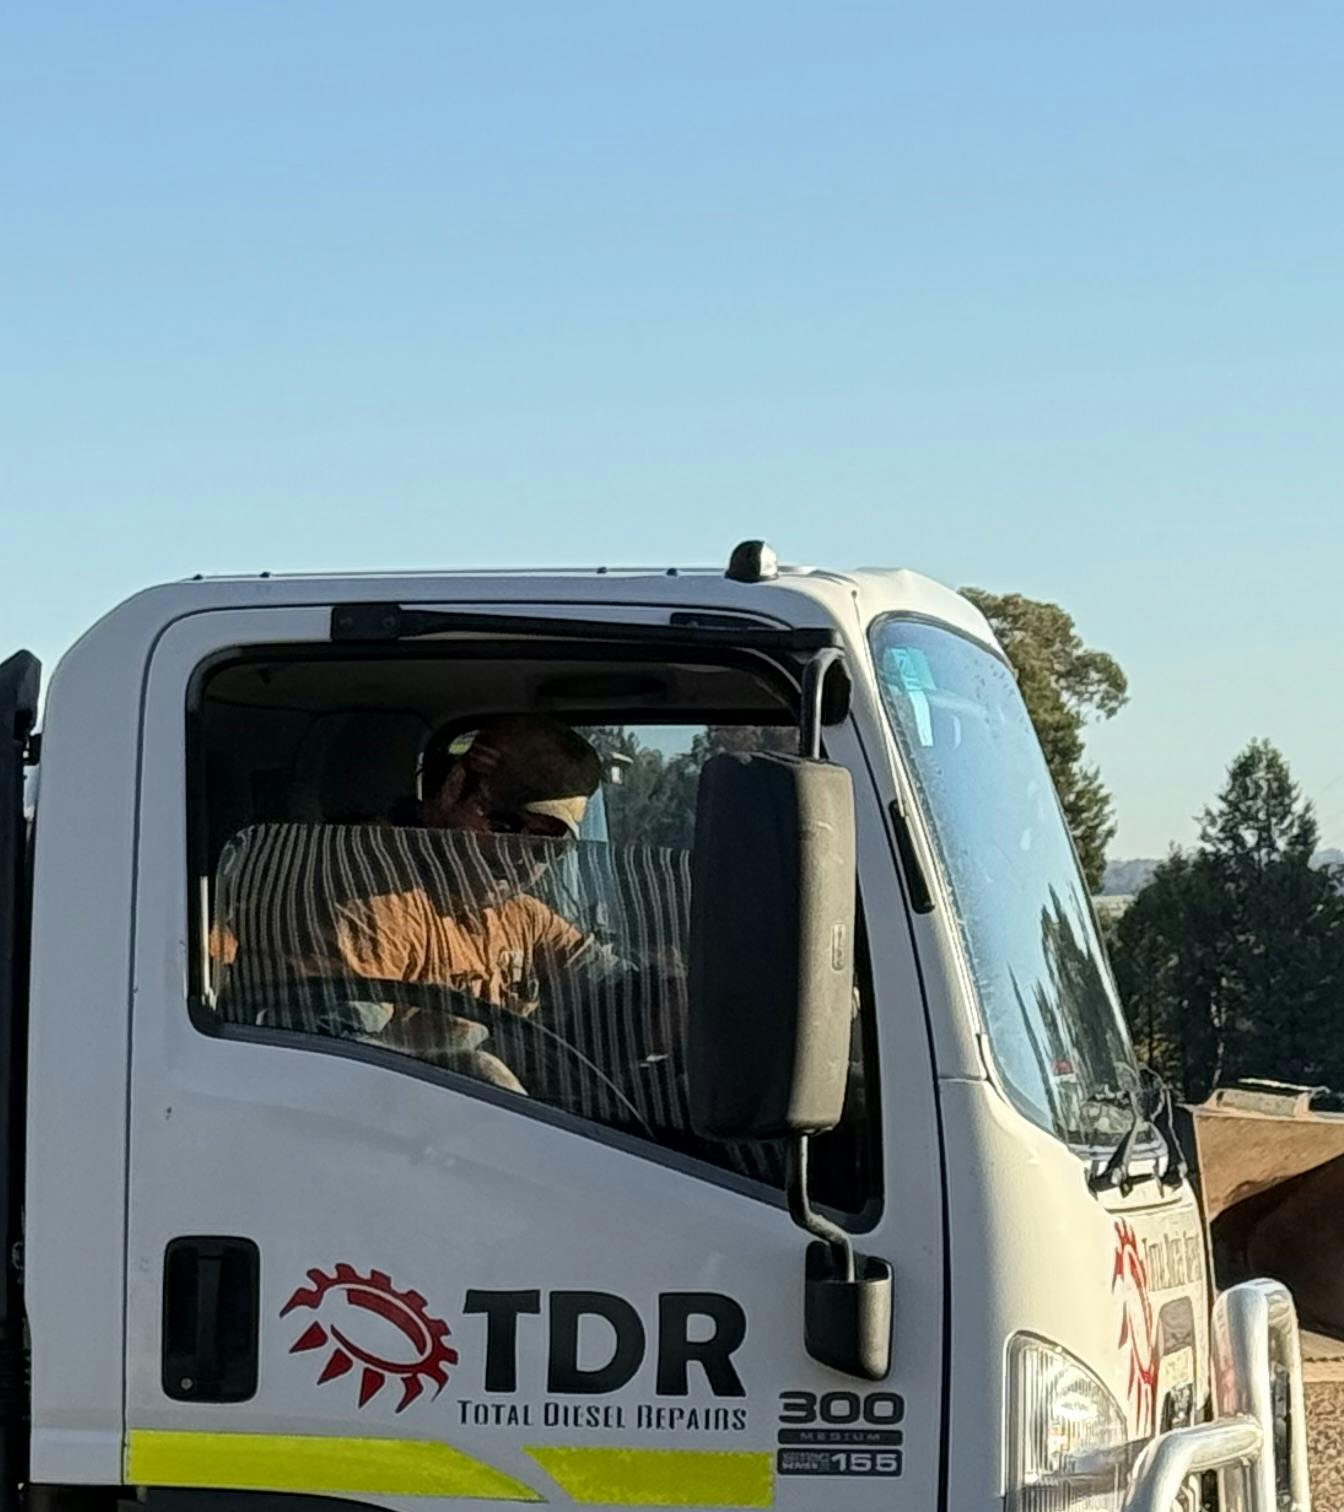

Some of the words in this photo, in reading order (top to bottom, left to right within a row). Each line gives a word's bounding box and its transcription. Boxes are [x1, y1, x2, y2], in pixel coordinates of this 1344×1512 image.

[462, 1288, 747, 1398] TDR
[457, 1400, 535, 1427] TOTAL
[543, 1402, 626, 1429] DIESEL
[637, 1404, 748, 1431] REPAIRS
[778, 1391, 905, 1425] 300
[831, 1452, 898, 1473] 155
